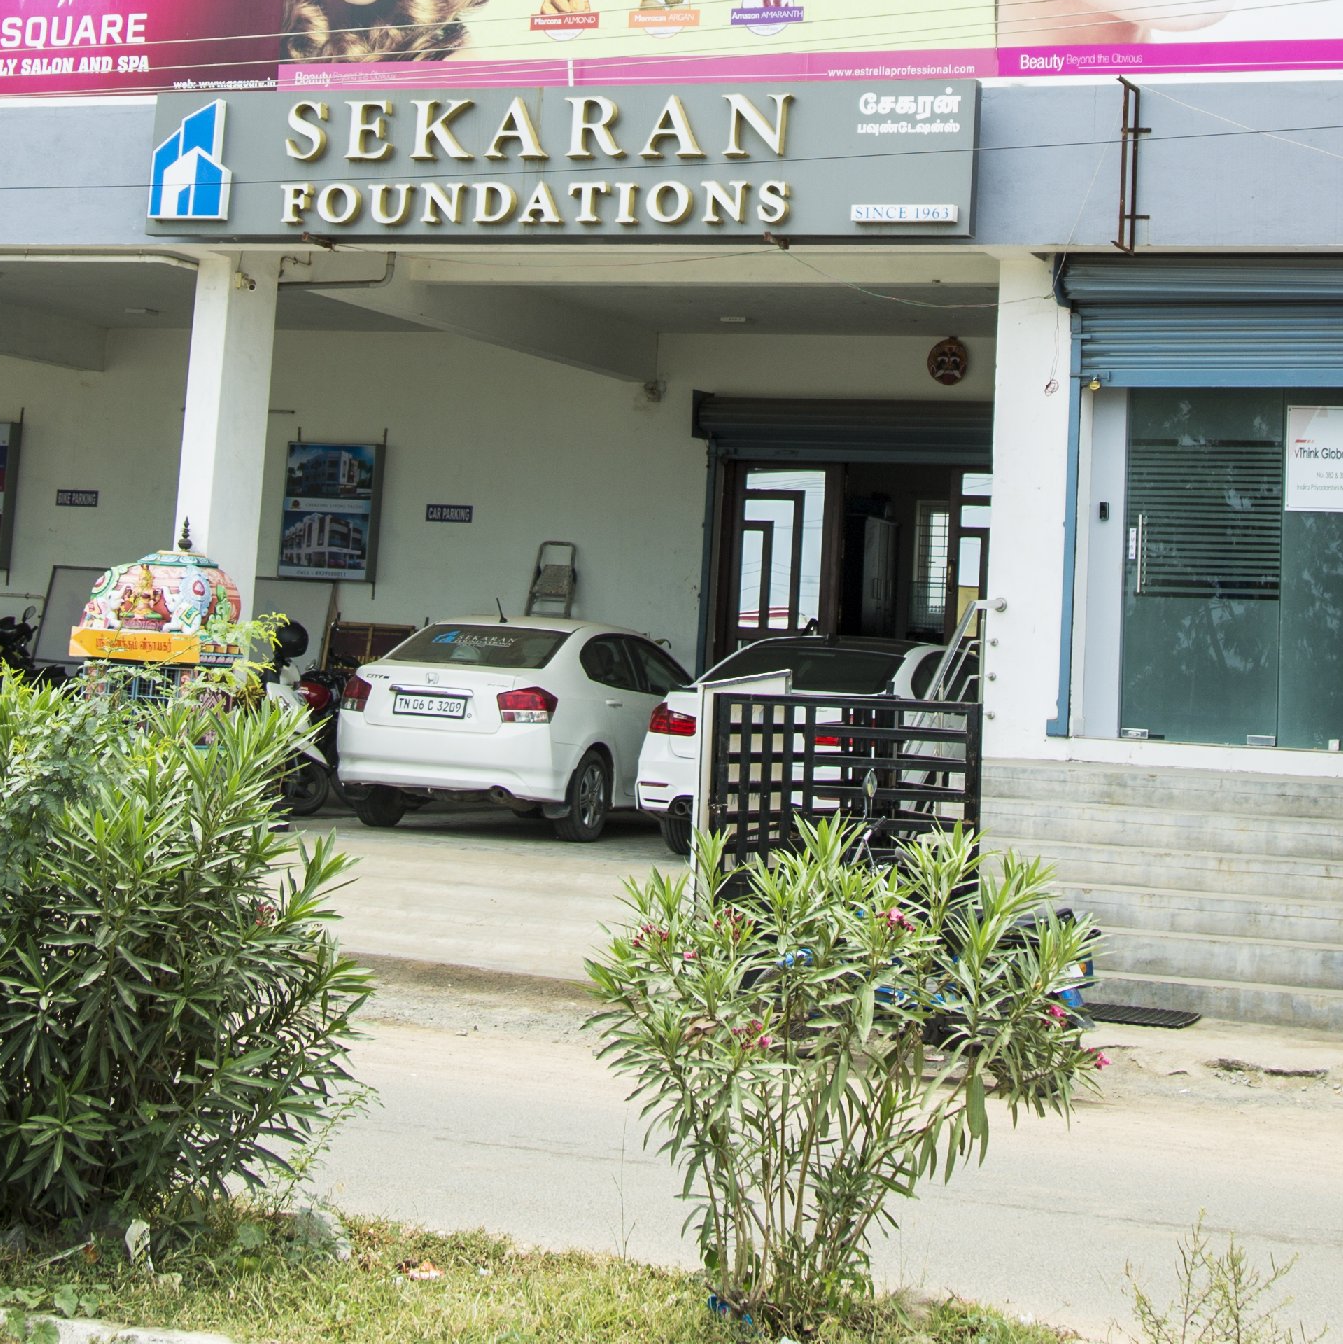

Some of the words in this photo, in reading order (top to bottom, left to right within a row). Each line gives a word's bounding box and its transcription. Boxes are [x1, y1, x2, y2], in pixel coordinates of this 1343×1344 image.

[563, 15, 597, 25] ALMOND
[760, 9, 804, 19] AMARANTH
[20, 56, 73, 76] SALON
[78, 55, 113, 74] AND
[117, 54, 150, 74] SPA
[1020, 53, 1065, 72] Beauty
[1066, 54, 1096, 65] Beyond
[1111, 53, 1143, 64] Obvious
[827, 64, 976, 78] www.estrellaprofessional.com
[859, 86, 962, 120] சேகரன்
[285, 90, 796, 164] SEKARAN
[280, 180, 793, 227] FOUNDATIONS
[855, 206, 908, 220] SINCE
[915, 206, 950, 220] 1963
[428, 507, 441, 520] CAR
[442, 508, 471, 522] PARKING
[399, 697, 410, 710] TN
[412, 698, 425, 711] 06
[427, 699, 434, 711] C
